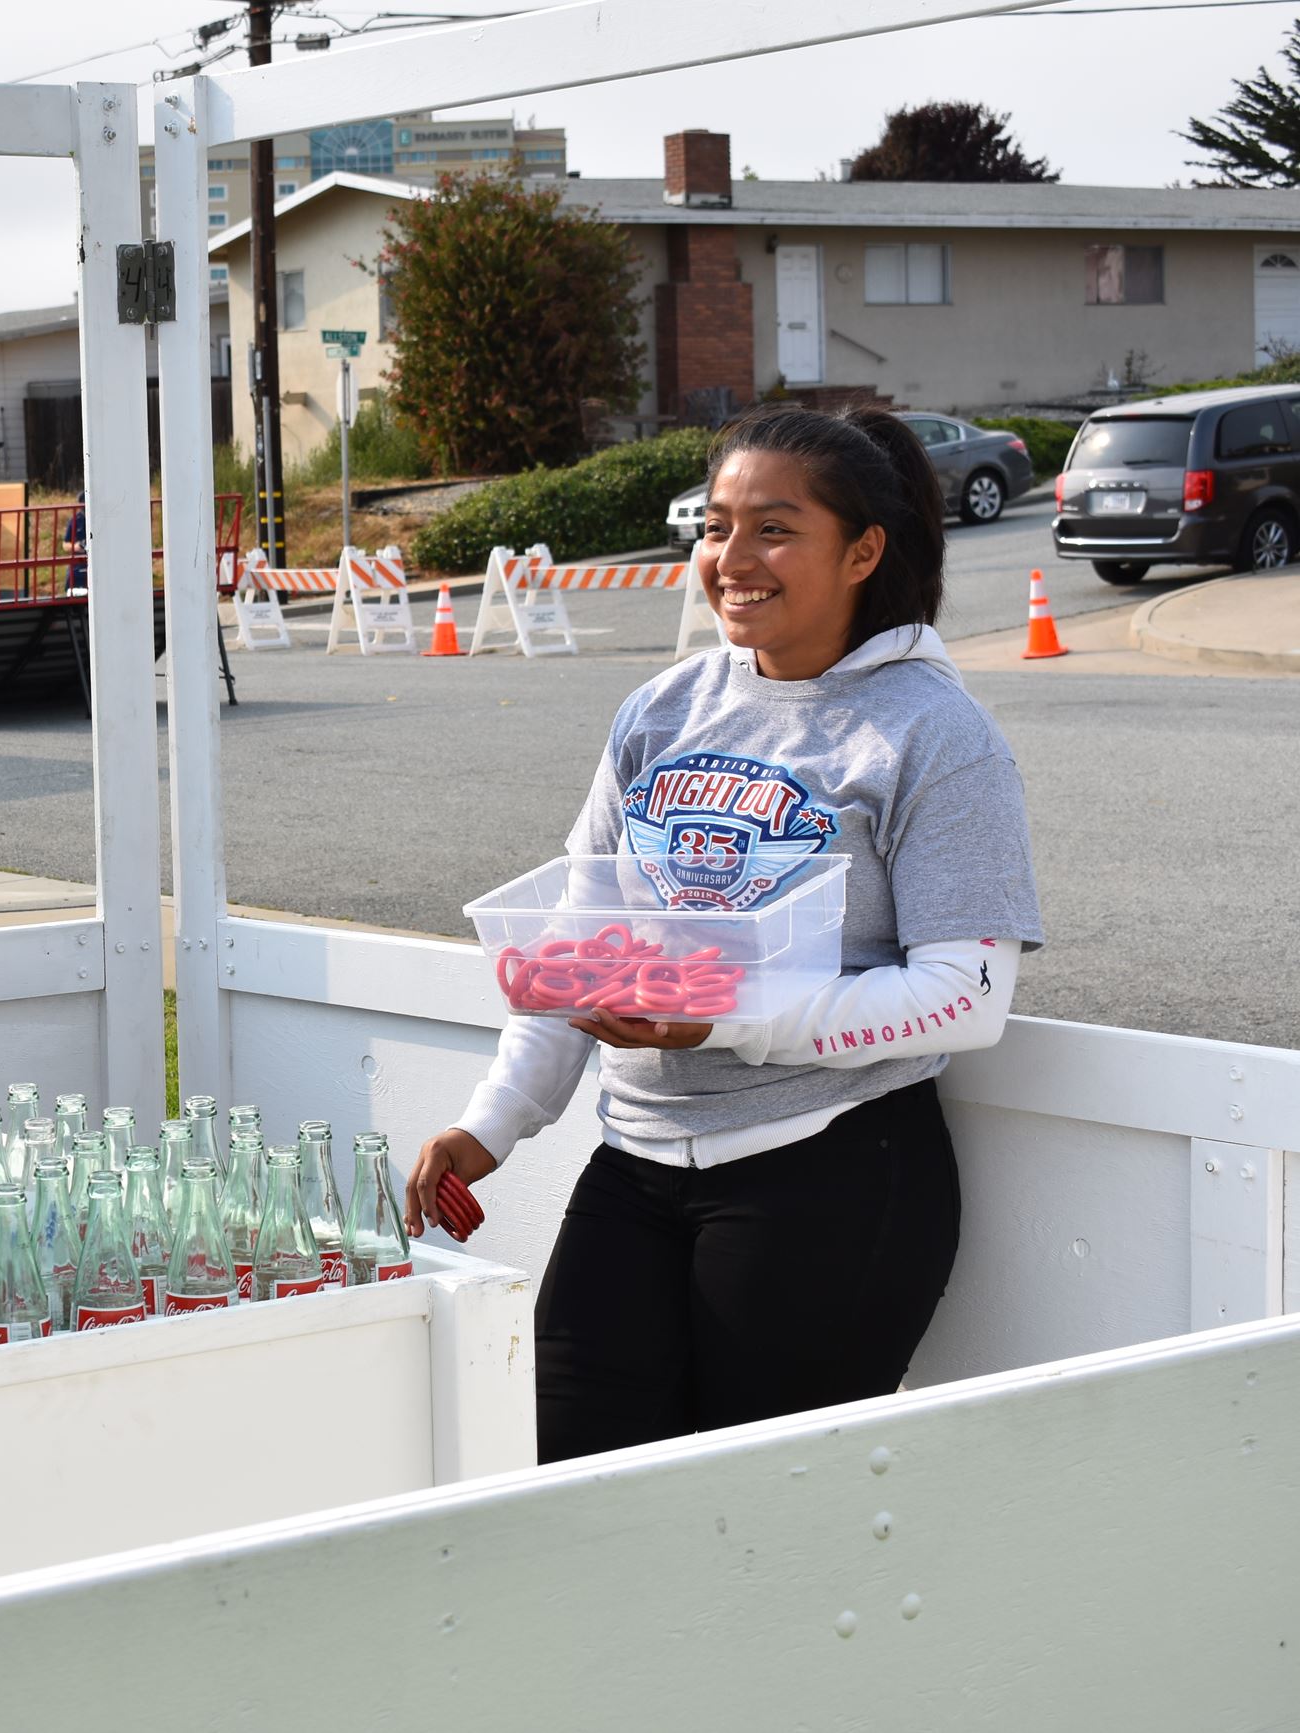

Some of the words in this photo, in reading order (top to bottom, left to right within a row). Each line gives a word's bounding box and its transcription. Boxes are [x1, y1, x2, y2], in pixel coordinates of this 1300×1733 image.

[414, 130, 466, 142] EMBASSY
[470, 129, 508, 140] SUITES
[125, 266, 142, 303] 4
[698, 757, 774, 778] NATIONAL
[647, 769, 748, 825] NIGHT
[733, 780, 801, 836] OUT
[675, 829, 741, 871] 35
[676, 869, 733, 885] ANNIVERSARY
[687, 889, 713, 899] 2018
[813, 996, 973, 1056] CALIFORNIA
